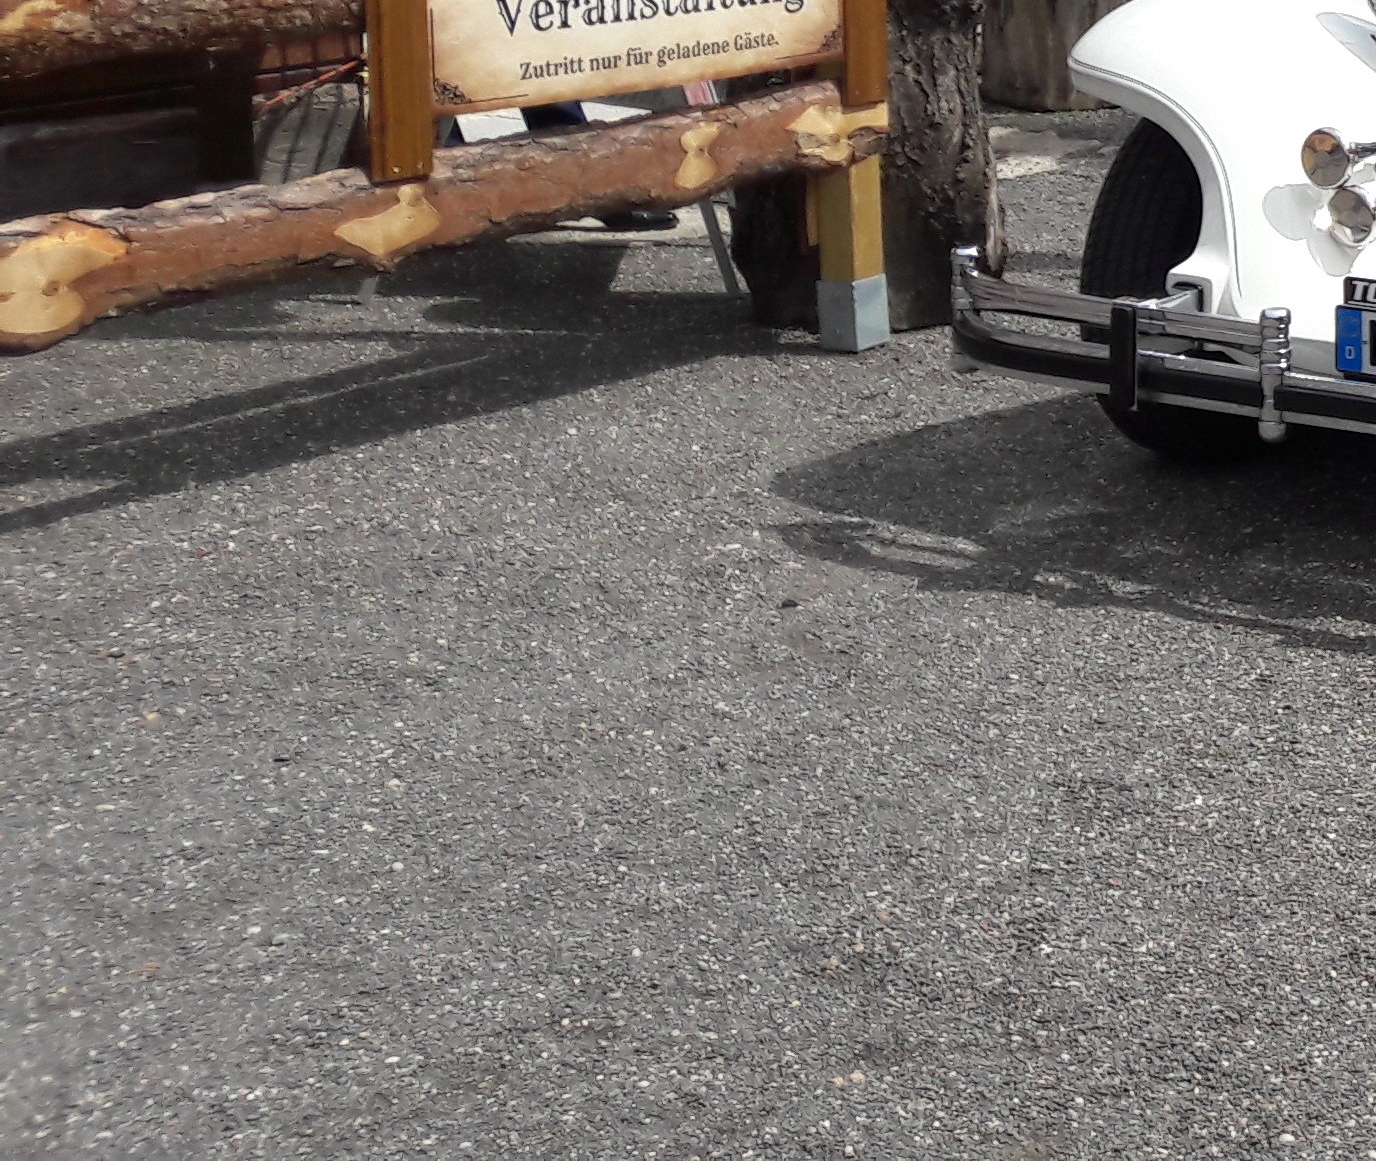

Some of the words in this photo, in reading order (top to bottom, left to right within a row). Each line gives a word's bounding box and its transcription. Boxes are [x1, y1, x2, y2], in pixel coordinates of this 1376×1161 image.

[519, 56, 586, 81] Zutritt
[589, 53, 623, 72] nur
[625, 46, 653, 67] für
[655, 37, 731, 67] geladene
[732, 32, 780, 52] Gäste.
